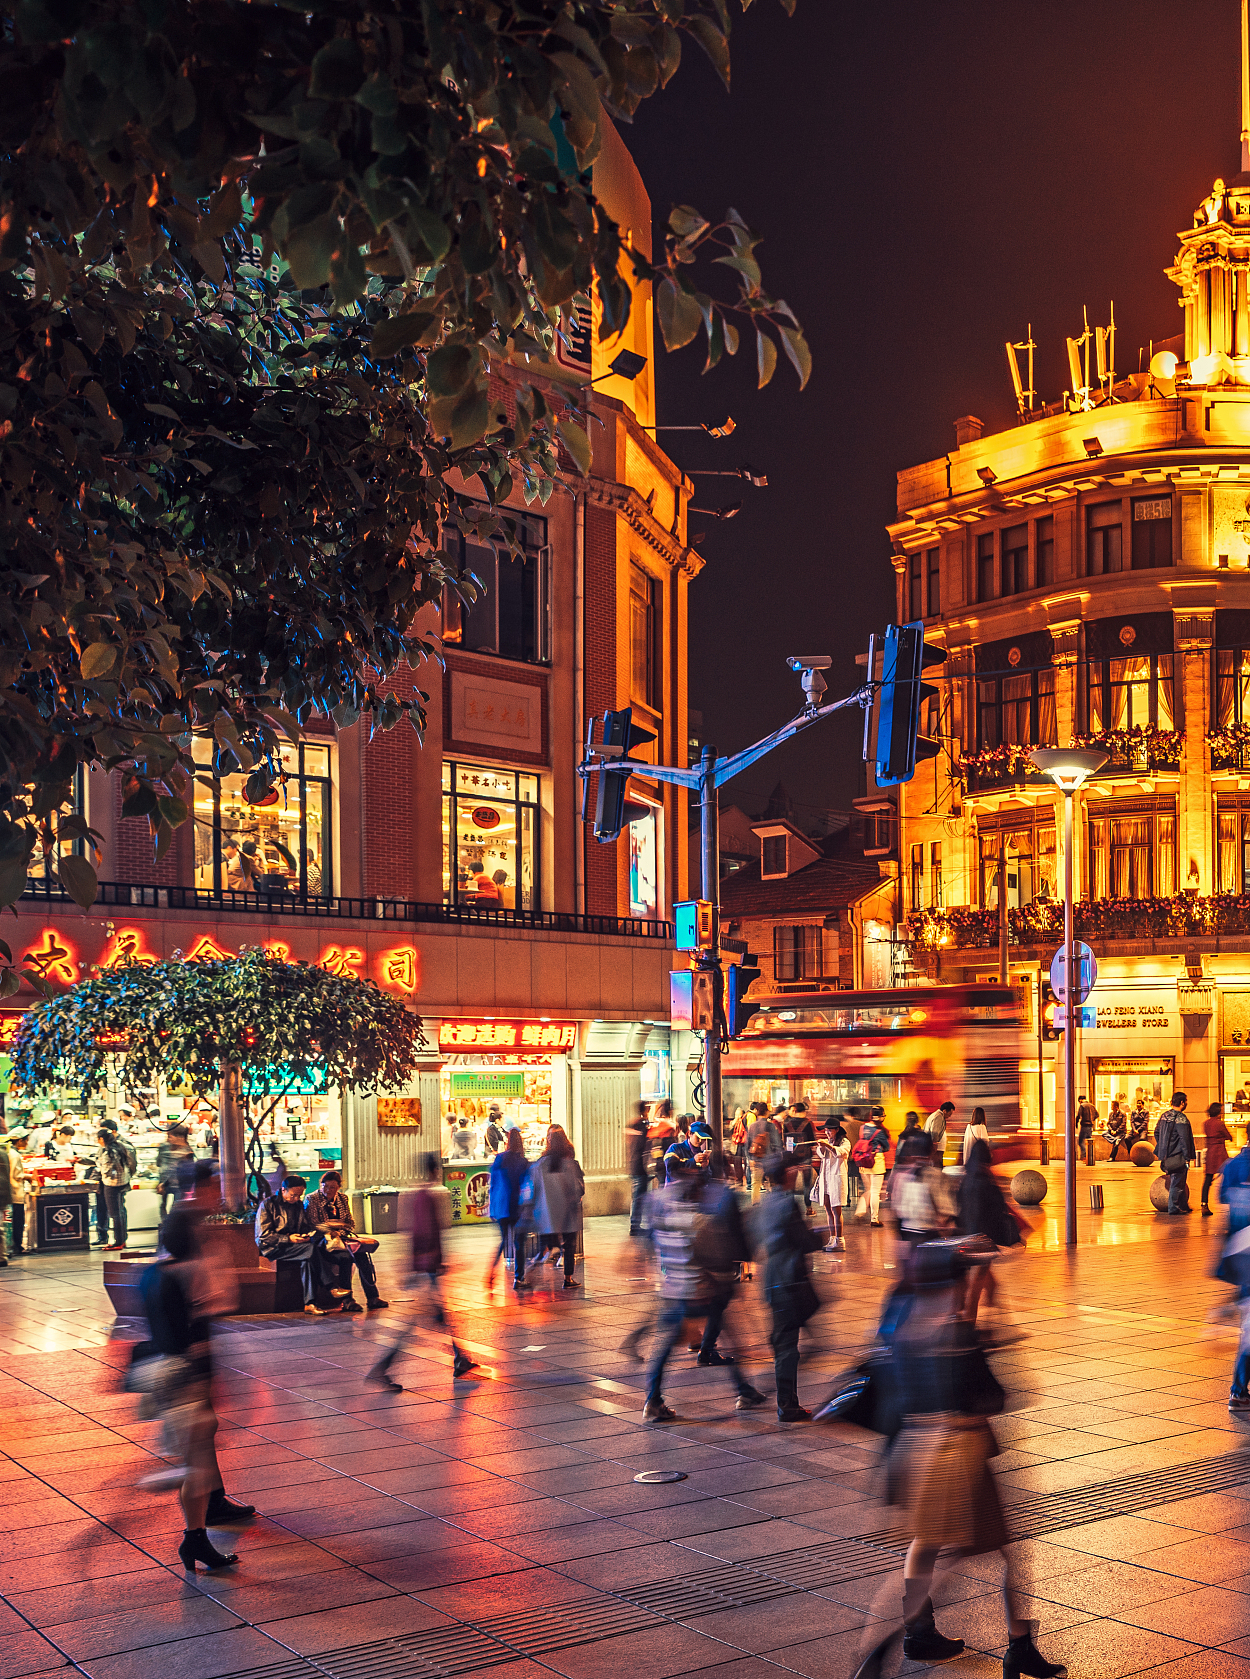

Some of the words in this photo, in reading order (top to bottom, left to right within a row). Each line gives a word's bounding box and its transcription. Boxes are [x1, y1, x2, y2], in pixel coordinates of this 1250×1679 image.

[1097, 1007, 1112, 1015] LAO
[1114, 1006, 1135, 1015] FENG
[1138, 1005, 1164, 1014] XIANG
[1096, 1019, 1137, 1028] EWELLERS
[1142, 1018, 1169, 1027] STORE
[451, 1186, 462, 1221] 关东煮
